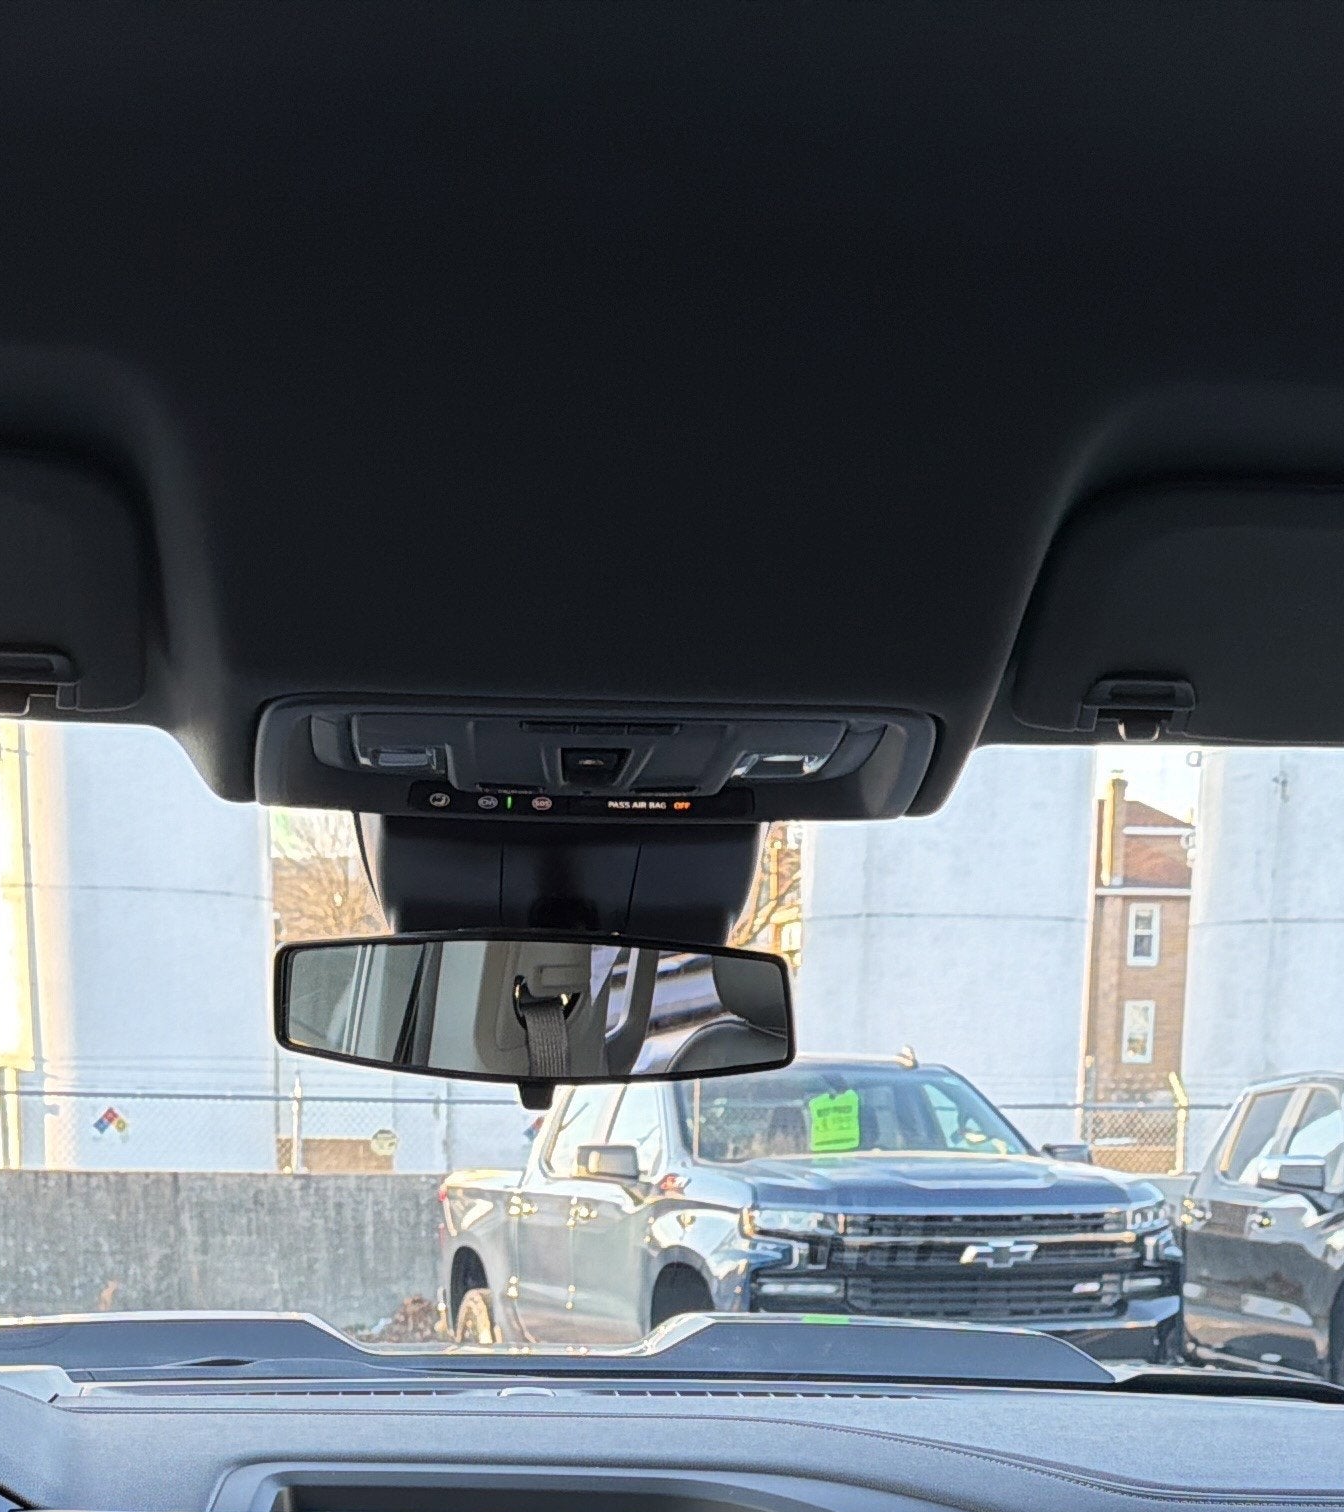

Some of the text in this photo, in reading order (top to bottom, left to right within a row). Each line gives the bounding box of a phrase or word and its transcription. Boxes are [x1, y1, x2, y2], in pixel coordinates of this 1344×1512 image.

[608, 800, 691, 811] PASS AIR BAG OFF
